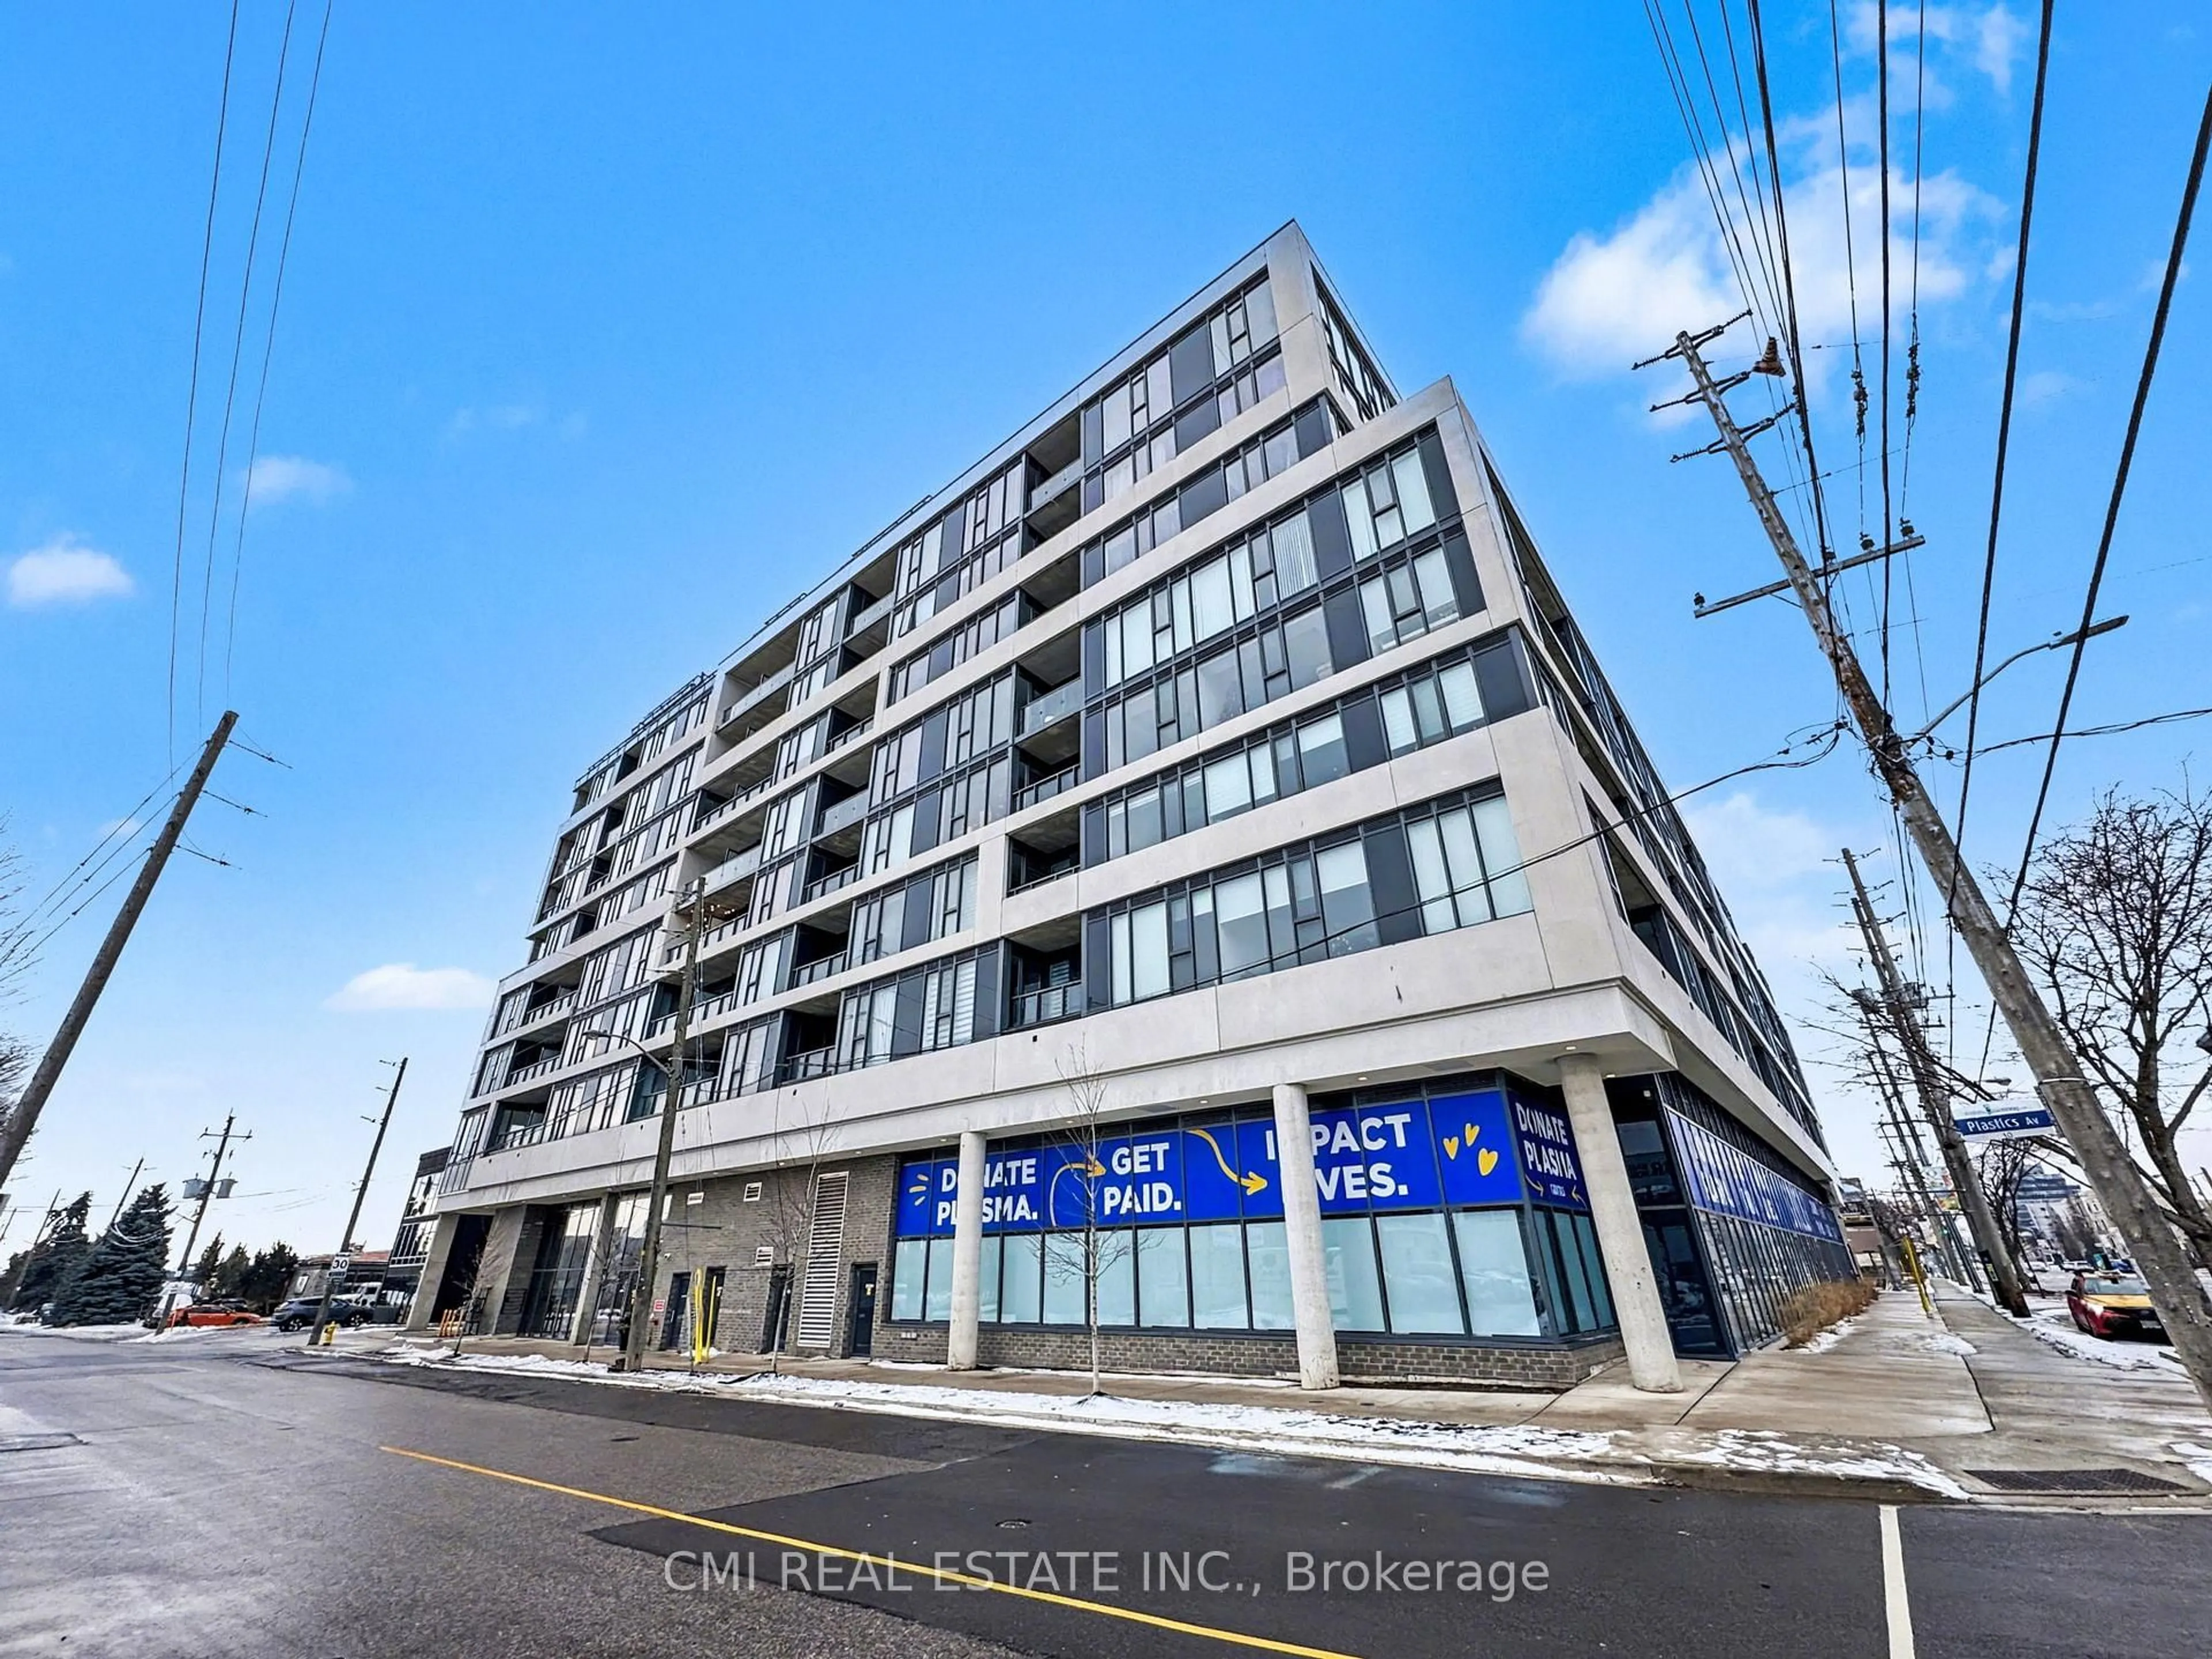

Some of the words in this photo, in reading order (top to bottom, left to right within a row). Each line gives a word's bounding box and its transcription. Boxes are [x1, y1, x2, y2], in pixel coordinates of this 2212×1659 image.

[1266, 1113, 1411, 1160] IPACT
[1967, 1118, 2020, 1132] Plastics
[2026, 1116, 2039, 1126] Av
[1112, 1142, 1169, 1175] GET
[941, 1158, 1036, 1192] DATE
[1315, 1162, 1409, 1201] VES.
[937, 1194, 1037, 1226] PLSMA.
[1104, 1183, 1181, 1215] PAID.
[333, 1259, 347, 1269] 30
